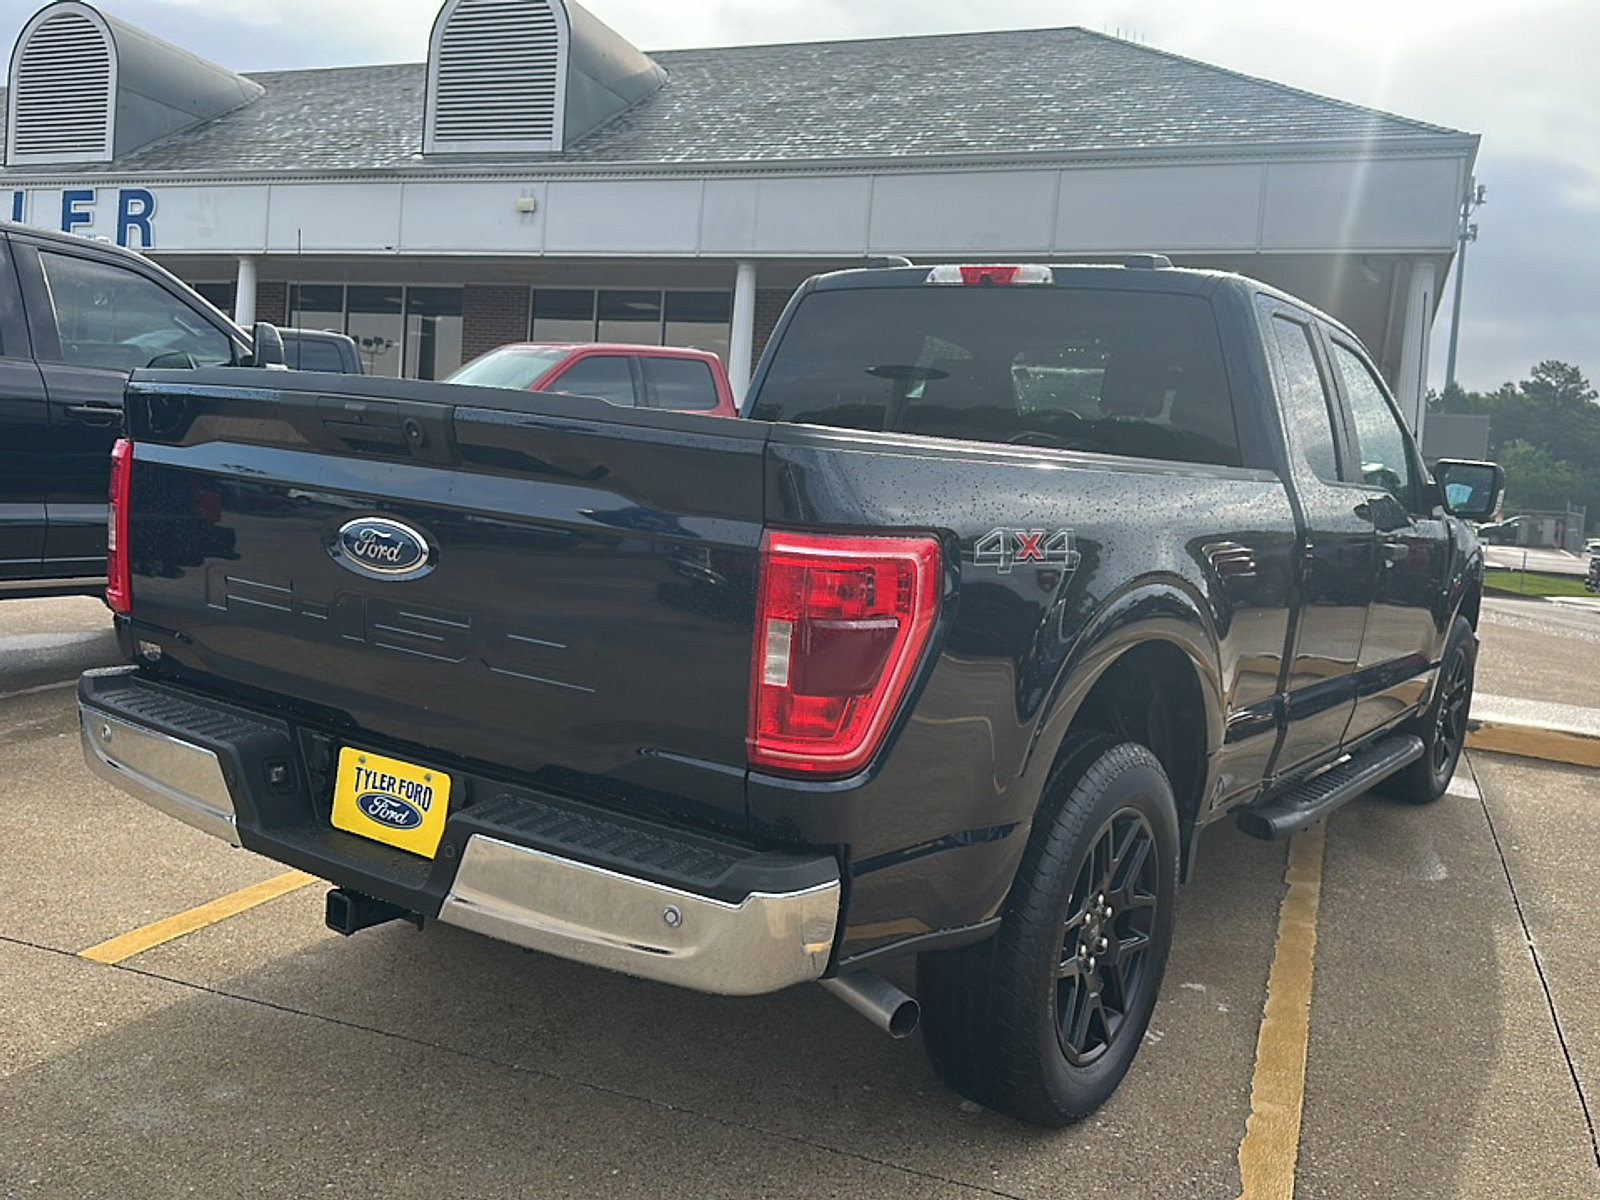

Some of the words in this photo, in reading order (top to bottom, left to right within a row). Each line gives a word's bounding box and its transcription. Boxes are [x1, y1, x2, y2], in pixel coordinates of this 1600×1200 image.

[353, 527, 404, 562] Ford
[354, 766, 397, 793] TYLER
[398, 778, 433, 812] FORD
[368, 796, 410, 825] Ford
